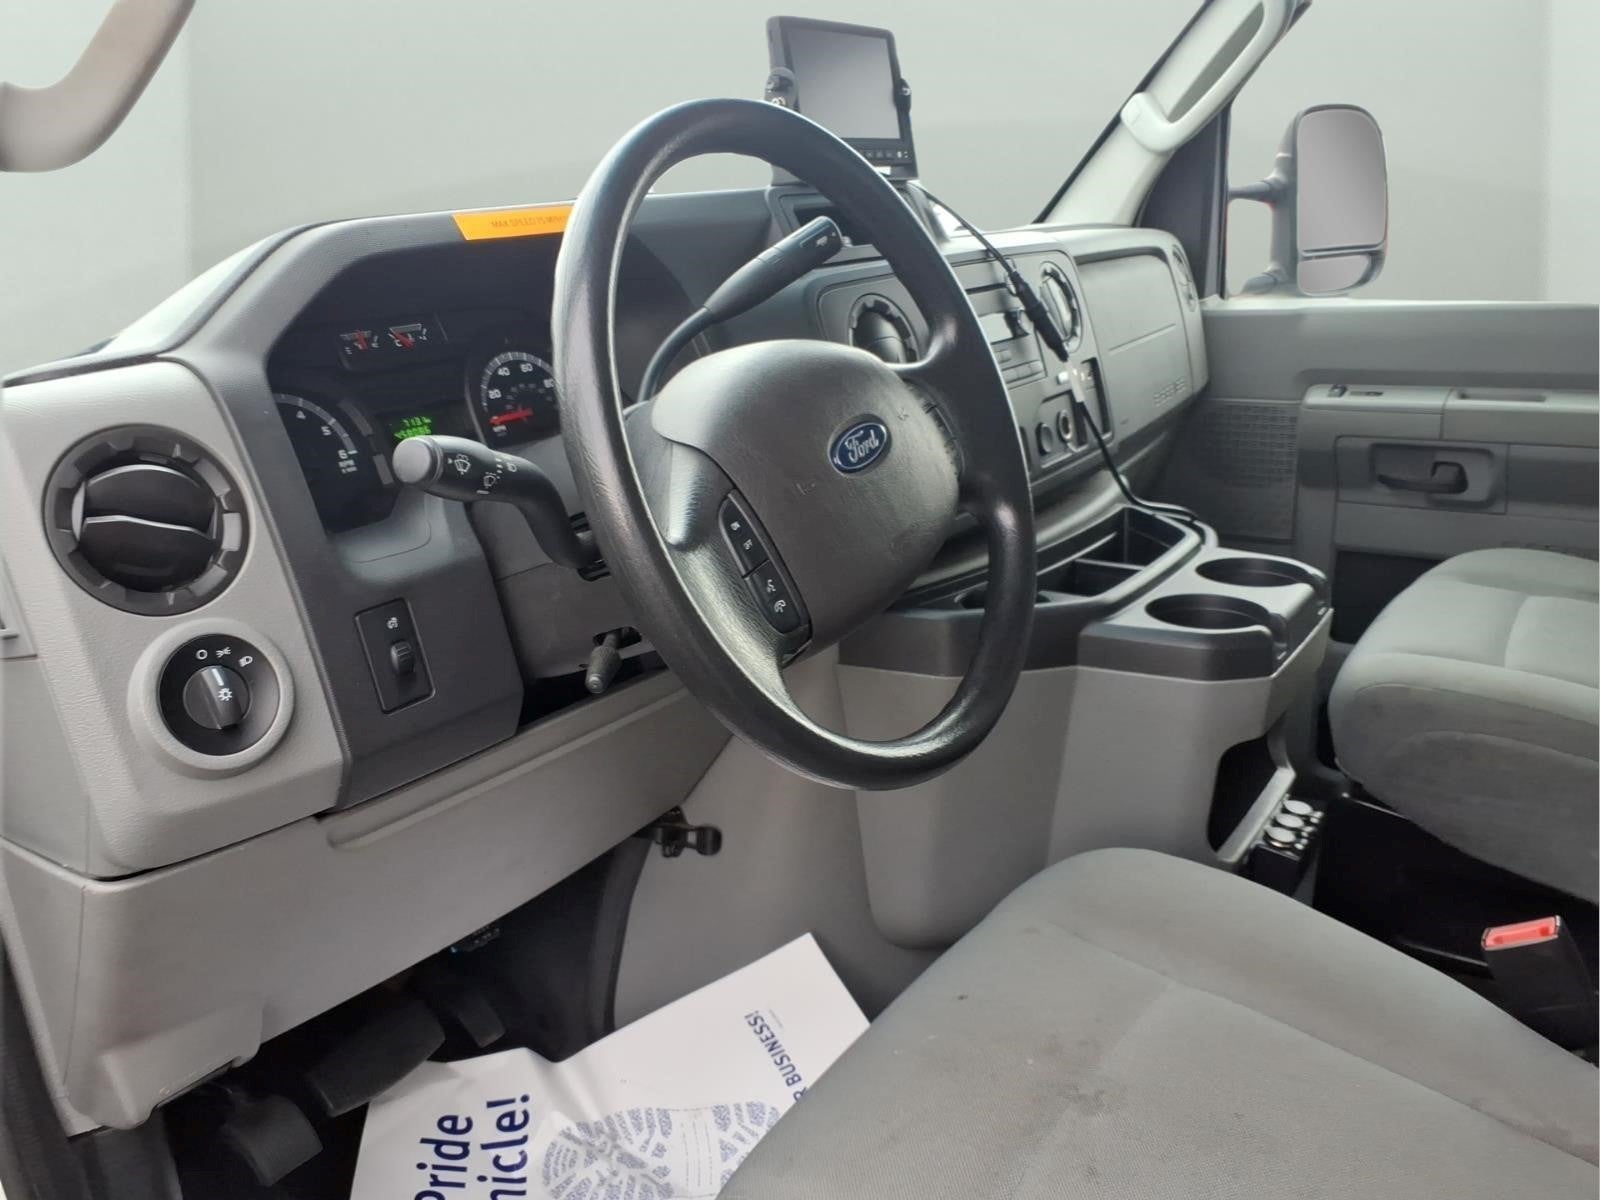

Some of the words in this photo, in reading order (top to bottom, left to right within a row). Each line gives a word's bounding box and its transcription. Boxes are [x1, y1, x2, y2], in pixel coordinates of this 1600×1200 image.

[296, 410, 306, 420] 4
[321, 426, 332, 436] 5
[844, 429, 879, 464] Ford
[337, 449, 349, 460] 6
[744, 1010, 802, 1087] BUSINESS!
